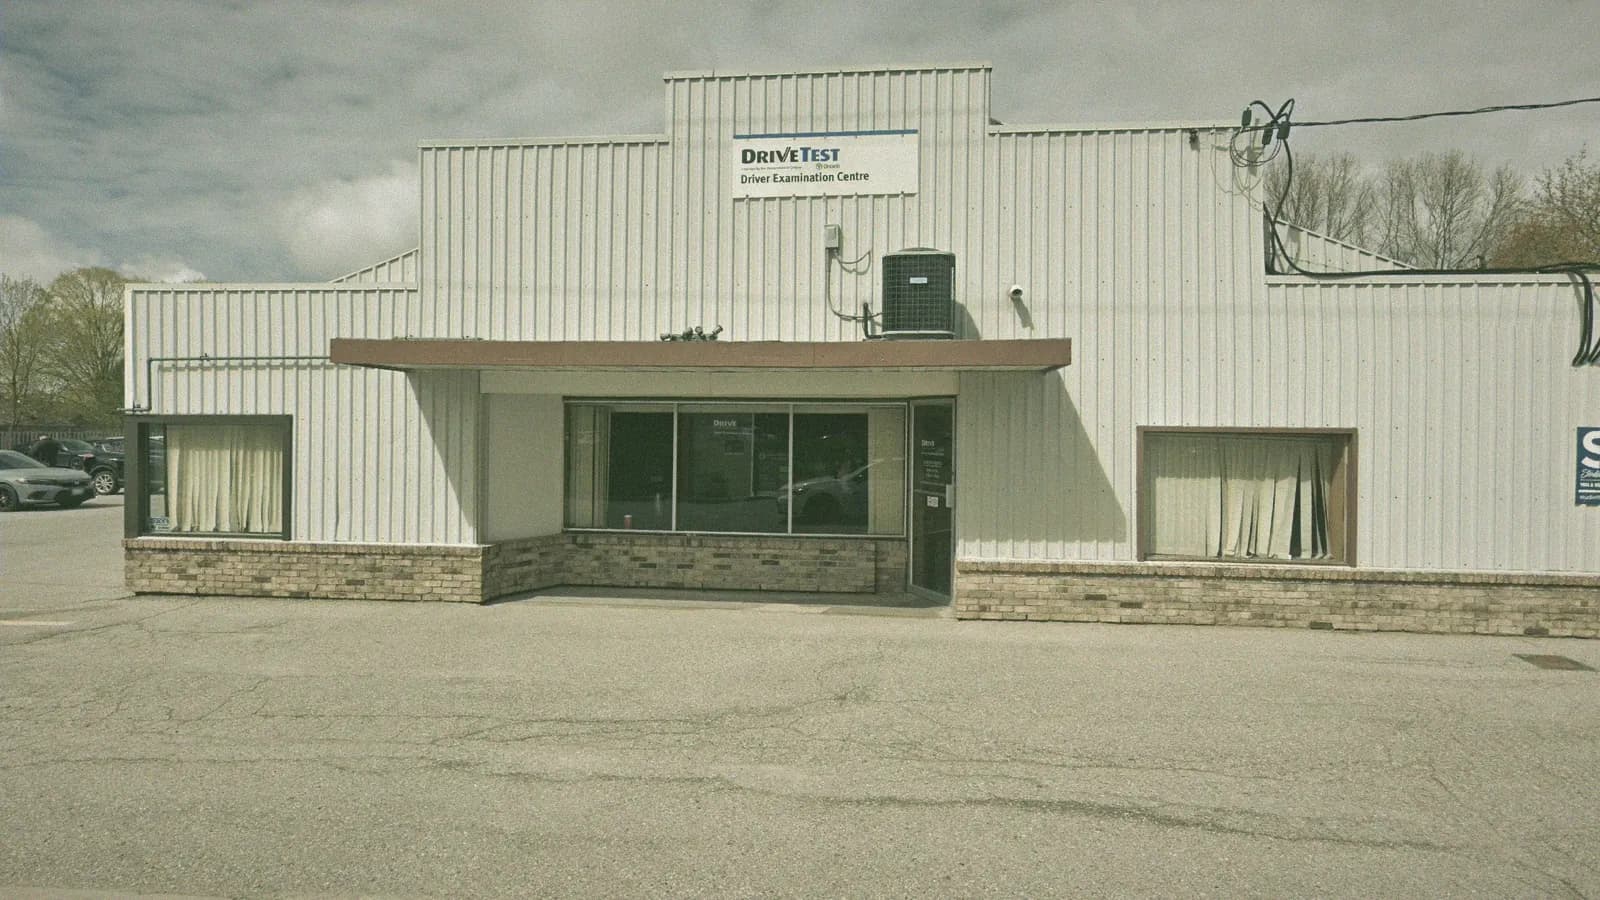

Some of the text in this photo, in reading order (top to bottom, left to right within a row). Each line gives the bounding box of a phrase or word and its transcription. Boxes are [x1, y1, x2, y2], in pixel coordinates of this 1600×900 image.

[740, 171, 870, 184] Driver Examination Centre
